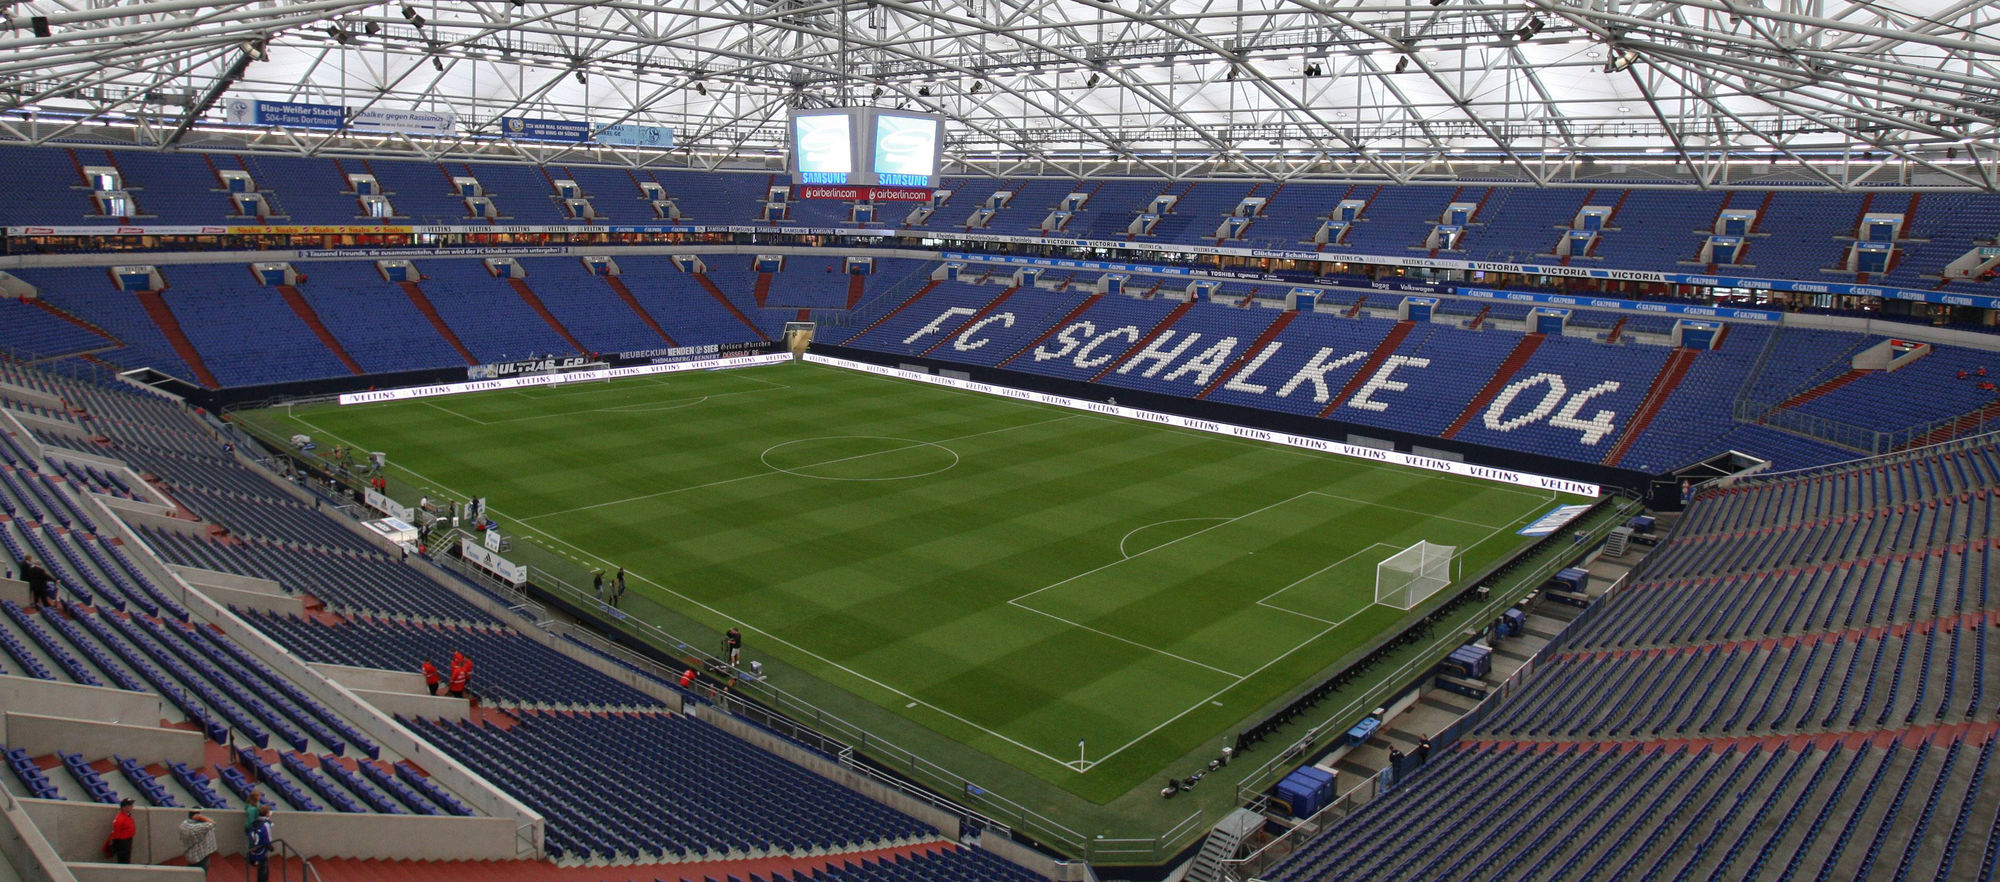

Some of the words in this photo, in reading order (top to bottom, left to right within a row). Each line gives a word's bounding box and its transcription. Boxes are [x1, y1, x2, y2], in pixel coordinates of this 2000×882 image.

[261, 104, 312, 115] Blau-Weißer
[313, 106, 341, 117] Stachel
[354, 109, 384, 118] halker
[385, 112, 407, 120] gegen
[409, 114, 443, 122] Rassismus
[301, 116, 337, 125] Dortmund
[802, 172, 847, 184] SAMSUNG
[879, 173, 928, 186] SAMSUNG
[812, 188, 857, 198] airberlin.com
[877, 190, 926, 200] airberlin.com
[1046, 238, 1075, 246] VICTORIA
[1088, 240, 1117, 248] VICTORIA
[1476, 262, 1520, 272] VICTORIA
[1541, 266, 1587, 277] VICTORIA
[1210, 270, 1236, 278] TOSHIBA
[1611, 271, 1661, 281] VICTORIA
[1400, 283, 1435, 293] Volkswagen
[620, 348, 667, 359] NEUBECKUM
[765, 353, 791, 361] VELTINS
[691, 360, 720, 369] VELTINS
[729, 357, 755, 365] VELTINS
[809, 355, 830, 364] VELTINS
[837, 359, 859, 369] VELTINS
[498, 359, 556, 375] ULTRAS
[608, 367, 640, 377] VELTINS
[651, 364, 680, 373] VELTINS
[866, 364, 889, 374] VELTINS
[516, 375, 551, 385] VELTINS
[563, 371, 596, 382] VELTINS
[898, 370, 922, 380] VELTINS
[903, 306, 1016, 351] FC
[1034, 321, 1431, 412] SCHALKE
[1481, 371, 1622, 446] 04
[930, 375, 956, 386] VELTINS
[412, 386, 451, 397] VELTINS
[465, 381, 501, 391] VELTINS
[965, 382, 992, 393] VELTINS
[352, 391, 395, 402] VELTINS
[1002, 388, 1030, 399] VELTINS
[1041, 394, 1071, 406] VELTINS
[1088, 402, 1120, 414] VELTINS
[1136, 410, 1169, 423] VELTINS
[1184, 419, 1220, 431] VELTINS
[1233, 427, 1271, 440] VELTINS
[1287, 436, 1328, 450] VELTINS
[1343, 445, 1386, 460] VELTINS
[1405, 455, 1451, 471] VELTINS
[1470, 466, 1519, 482] VELTINS
[1540, 478, 1593, 495] VELTINS
